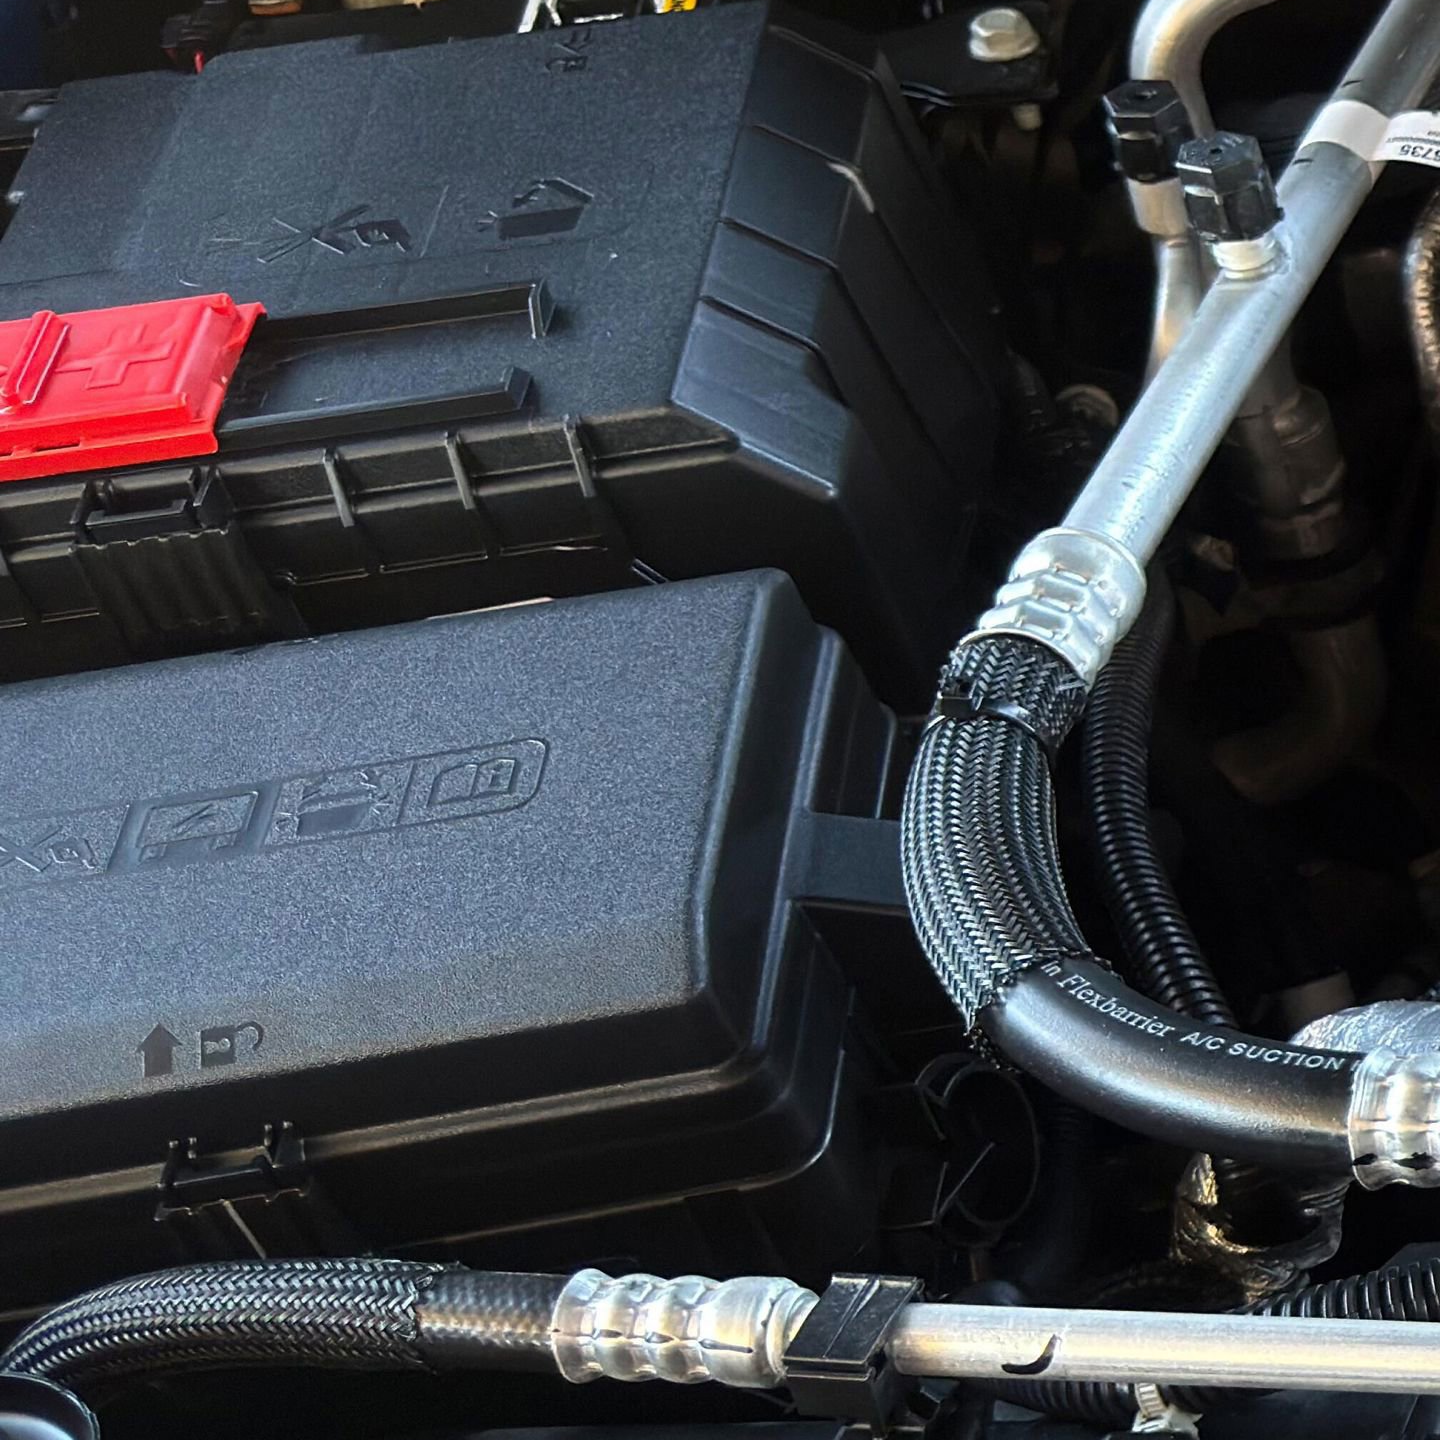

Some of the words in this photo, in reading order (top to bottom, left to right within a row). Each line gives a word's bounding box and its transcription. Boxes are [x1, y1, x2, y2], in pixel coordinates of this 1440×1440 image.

[1057, 973, 1177, 1038] Flexbarrier
[1179, 1030, 1226, 1051] A/C
[1228, 1041, 1347, 1072] SUCTION
